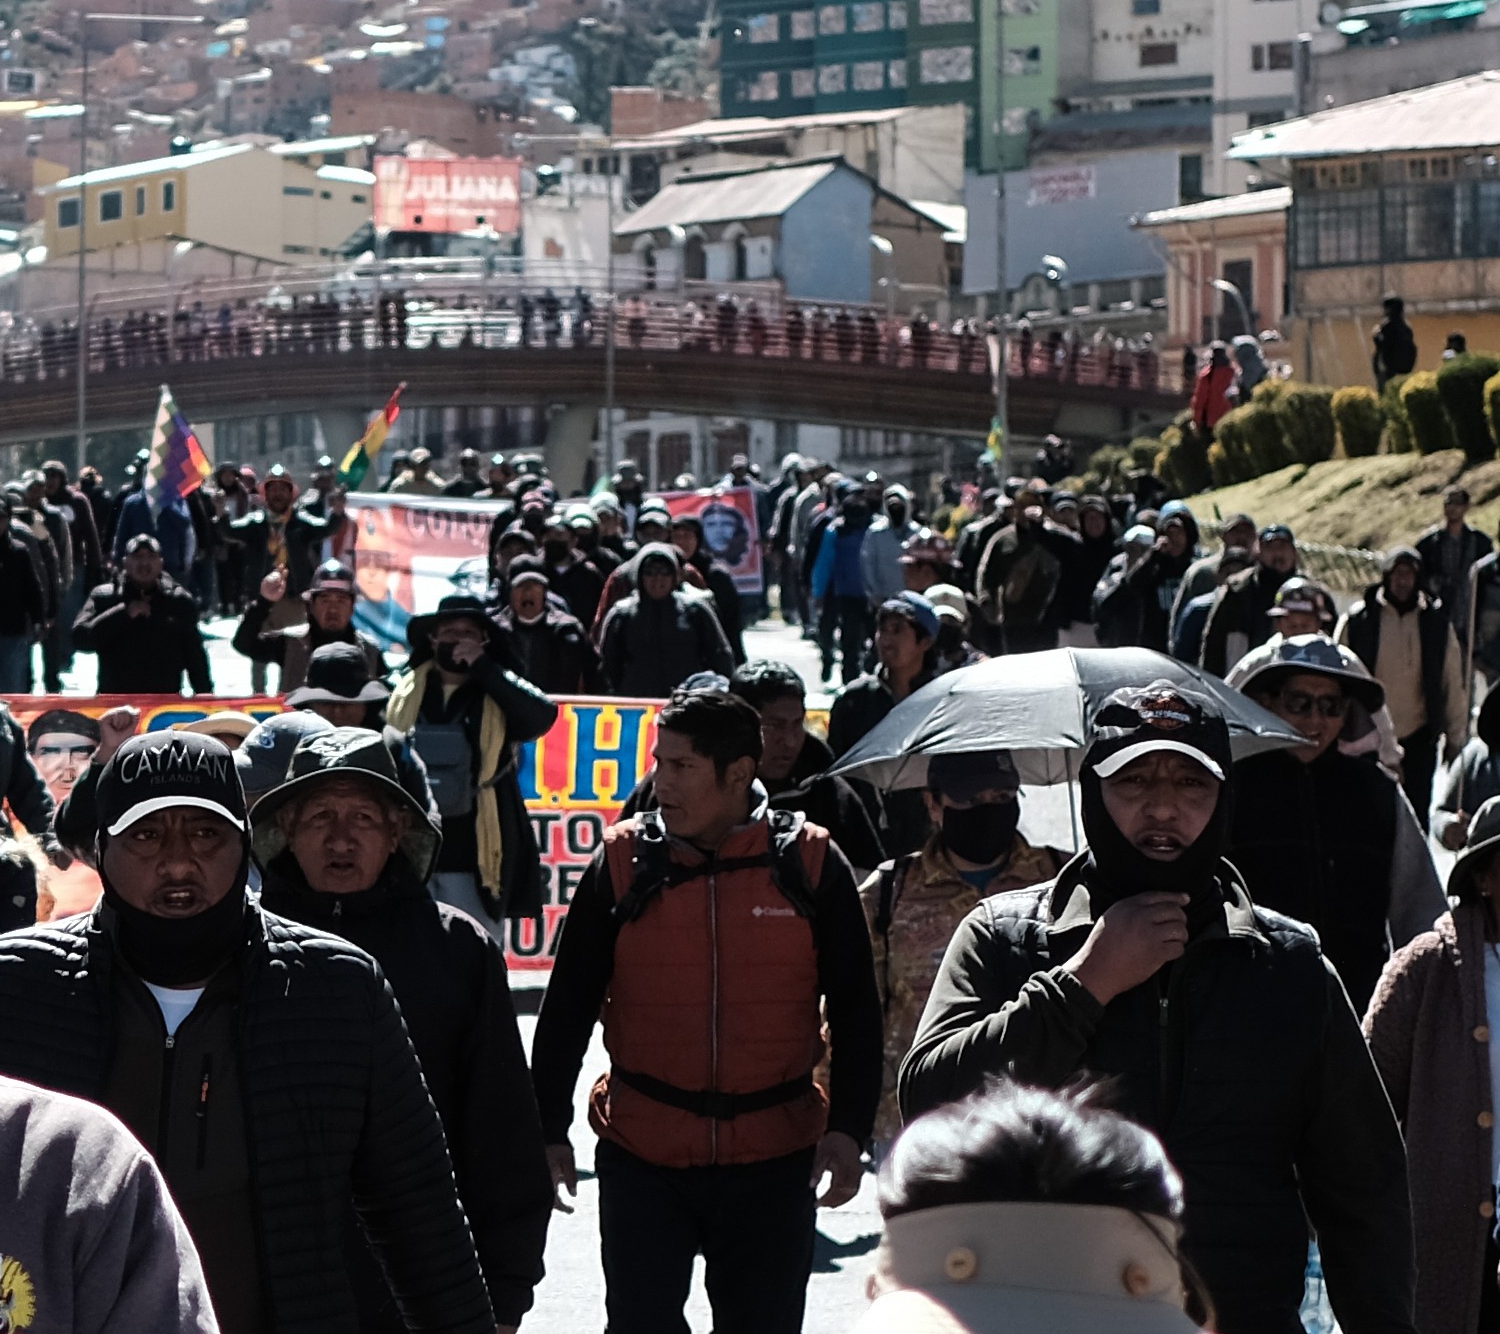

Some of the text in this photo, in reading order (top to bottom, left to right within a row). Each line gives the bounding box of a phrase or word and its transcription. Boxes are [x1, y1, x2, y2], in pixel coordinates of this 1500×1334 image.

[403, 174, 519, 202] JULIANA
[120, 742, 228, 785] CAYMAN
[150, 772, 201, 785] ISLANDS
